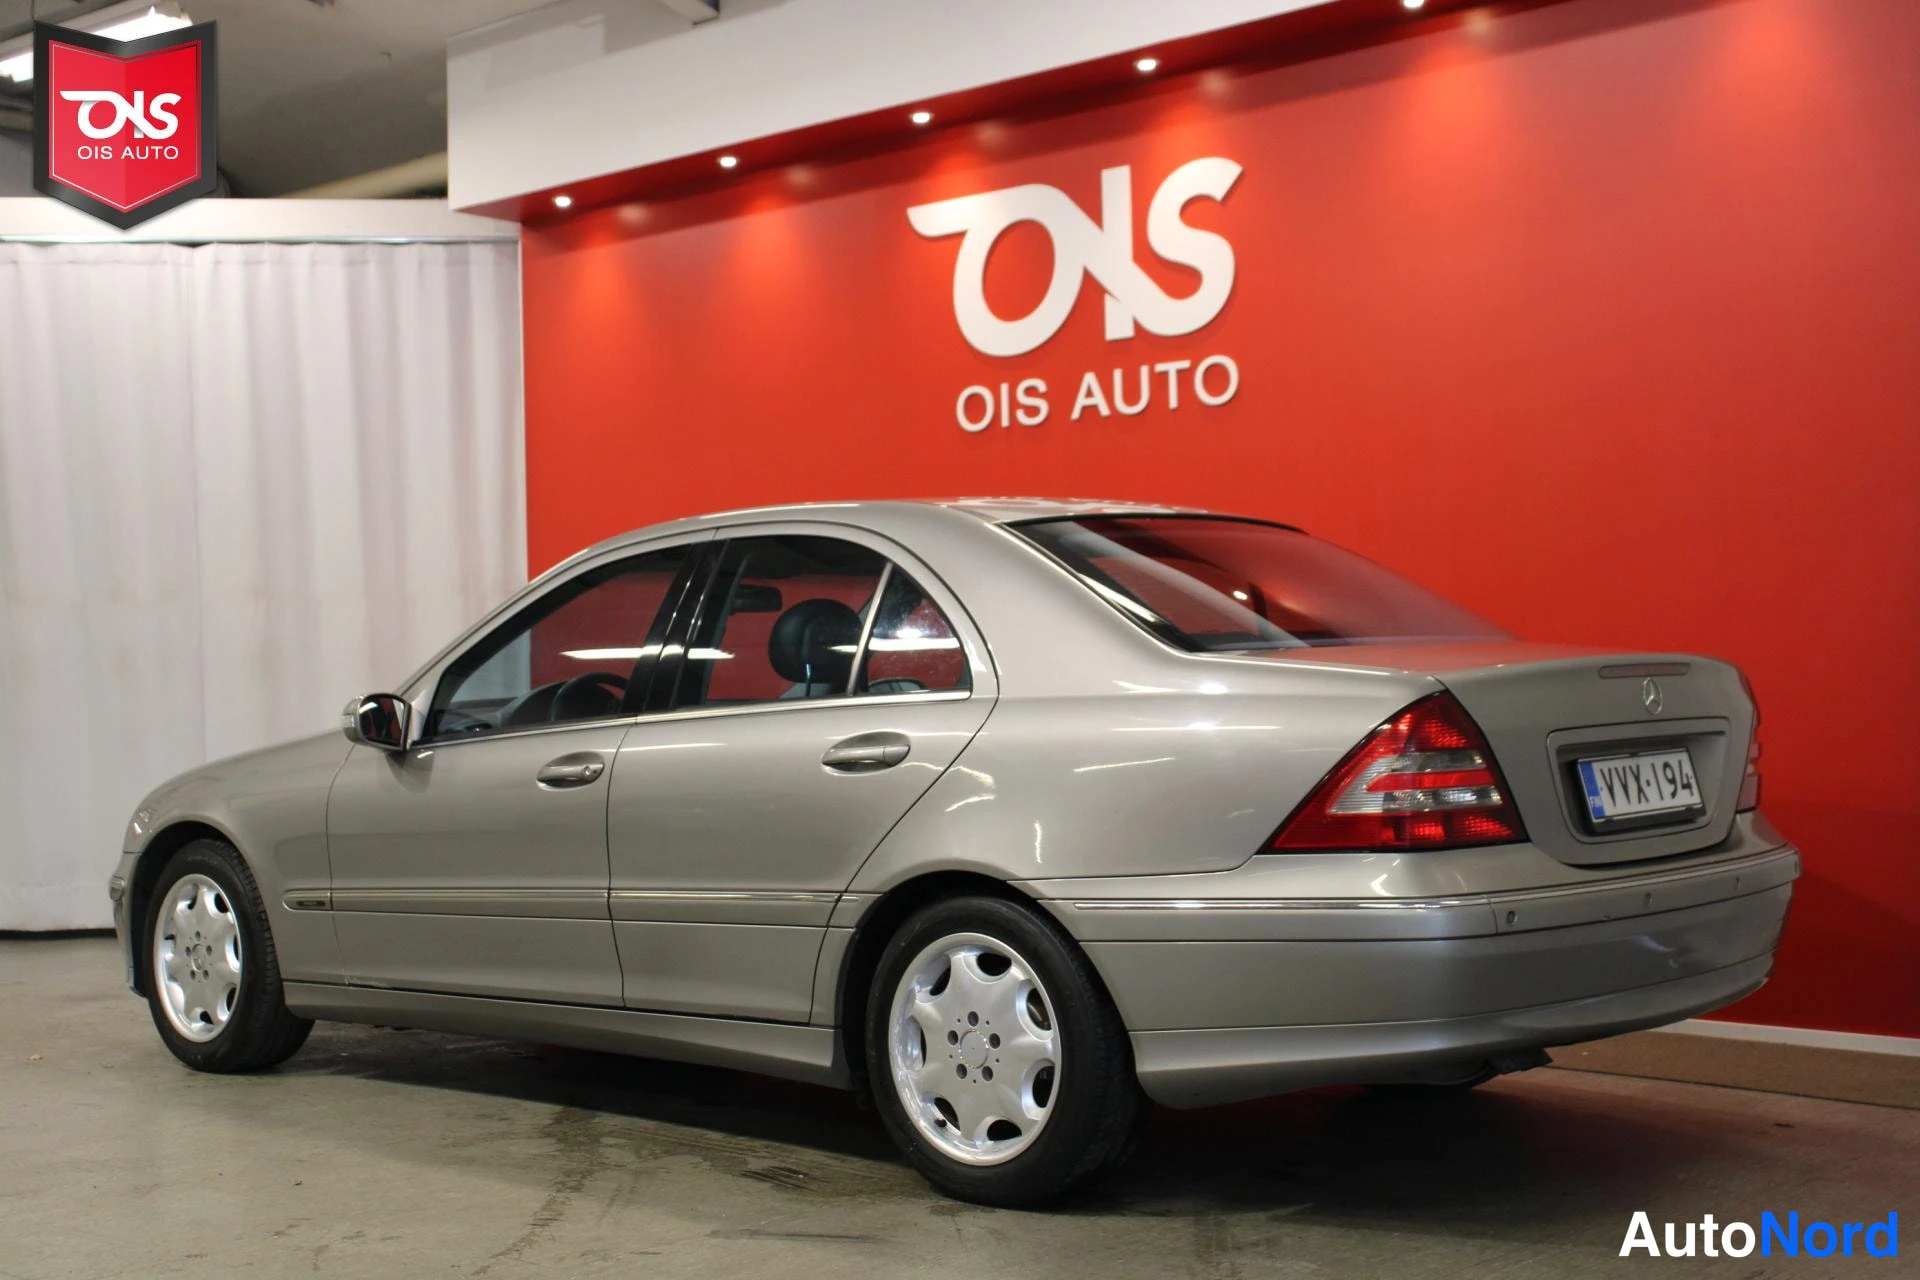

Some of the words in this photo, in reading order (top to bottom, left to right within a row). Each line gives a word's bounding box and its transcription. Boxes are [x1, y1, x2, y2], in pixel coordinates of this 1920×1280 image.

[956, 378, 1050, 432] OIS
[1070, 354, 1239, 420] AUTO
[1600, 760, 1694, 807] VVX-194
